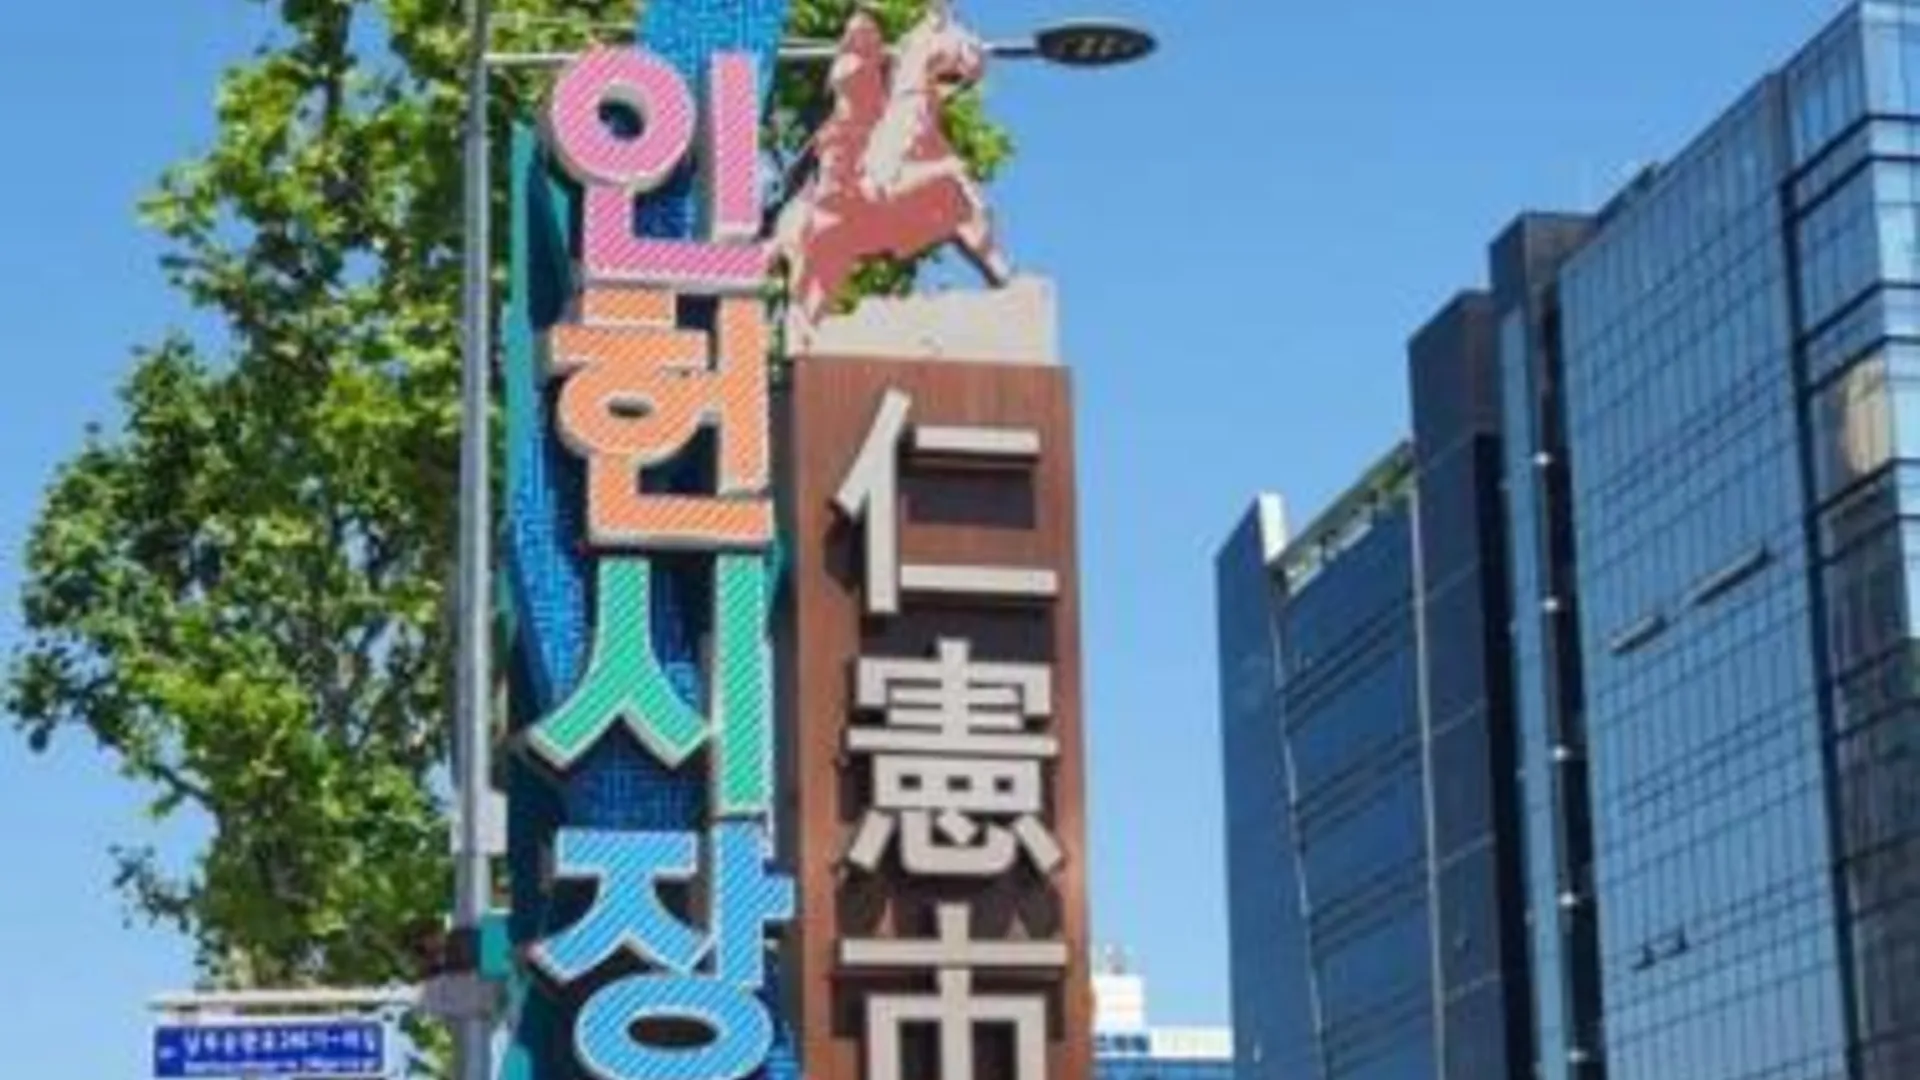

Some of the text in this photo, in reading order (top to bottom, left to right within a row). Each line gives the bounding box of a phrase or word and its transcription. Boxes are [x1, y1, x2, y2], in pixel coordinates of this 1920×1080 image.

[528, 44, 794, 1080] 인헌시장
[836, 388, 1068, 1080] 仁憲市
